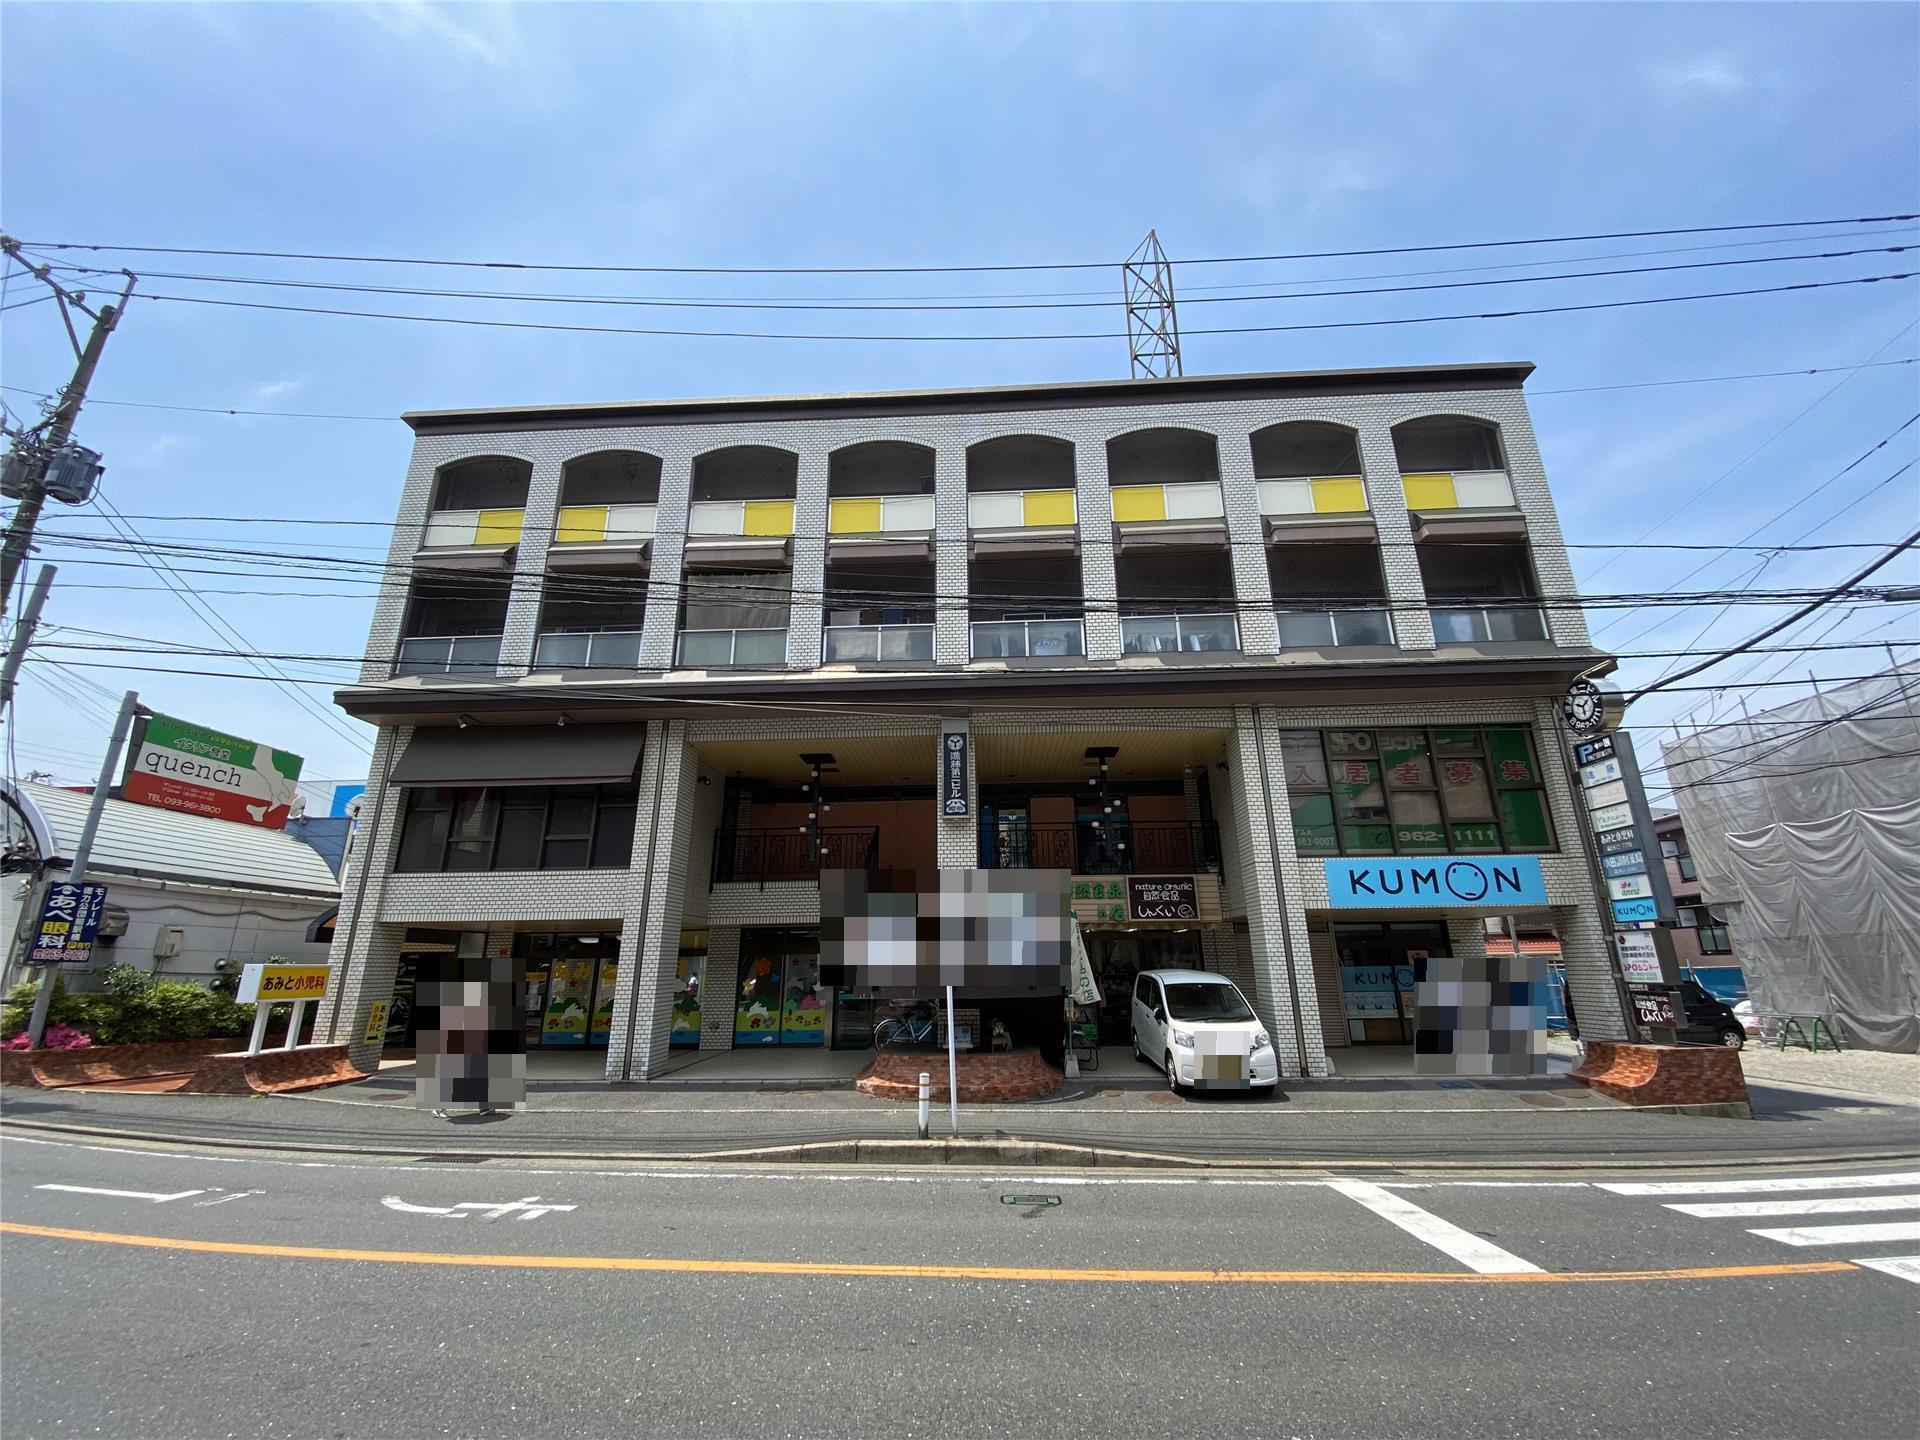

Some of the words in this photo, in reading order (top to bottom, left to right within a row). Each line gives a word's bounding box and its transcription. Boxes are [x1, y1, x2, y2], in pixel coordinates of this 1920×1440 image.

[1578, 744, 1594, 764] P
[145, 751, 242, 787] quench
[1292, 759, 1529, 785] 入居者募集
[146, 792, 162, 803] TEL
[164, 796, 222, 814] 093-961-3800
[1074, 880, 1122, 899] 然食品
[1135, 883, 1163, 891] nature
[1349, 862, 1522, 902] KUMON
[1143, 890, 1180, 901] 自然食品
[86, 887, 105, 926] モノレール
[1617, 904, 1654, 916] KUMON
[262, 976, 326, 991] あみと小児科
[1354, 968, 1416, 988] KUMO
